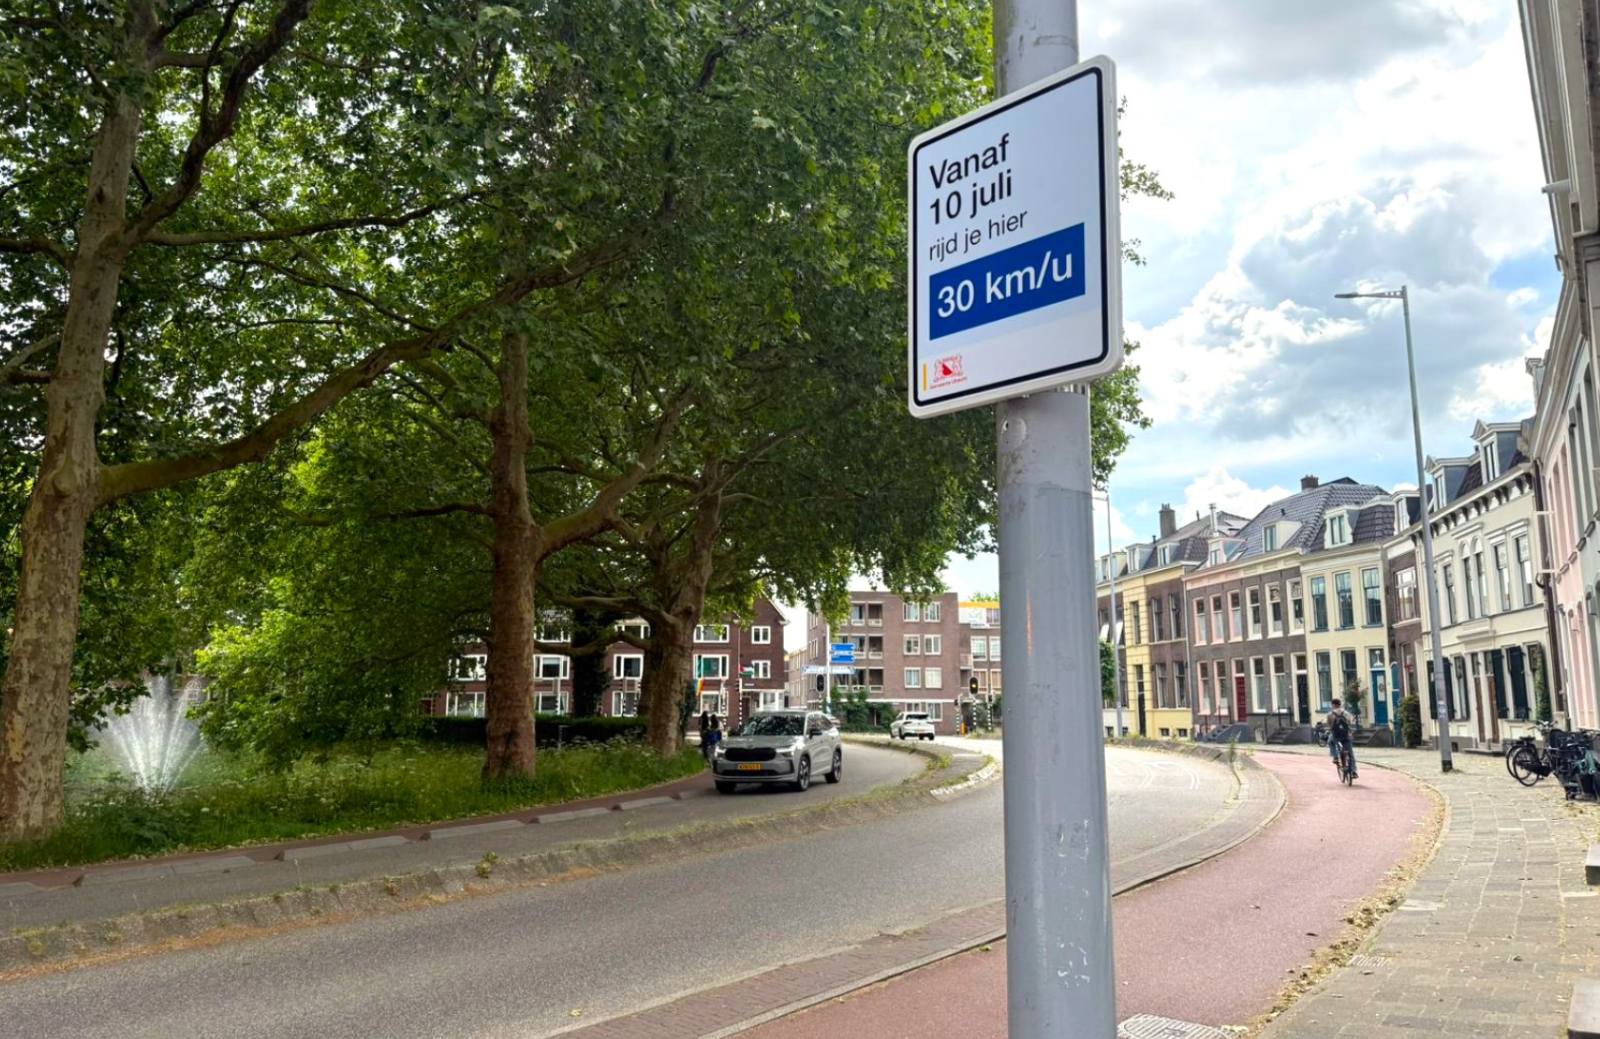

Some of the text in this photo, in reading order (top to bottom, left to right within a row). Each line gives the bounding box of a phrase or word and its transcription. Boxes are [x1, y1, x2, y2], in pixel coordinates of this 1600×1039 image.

[929, 132, 1010, 189] Vanaf
[930, 168, 1012, 225] 10 juli
[929, 210, 1028, 262] rijd je hier
[937, 250, 1073, 318] 30 km/u
